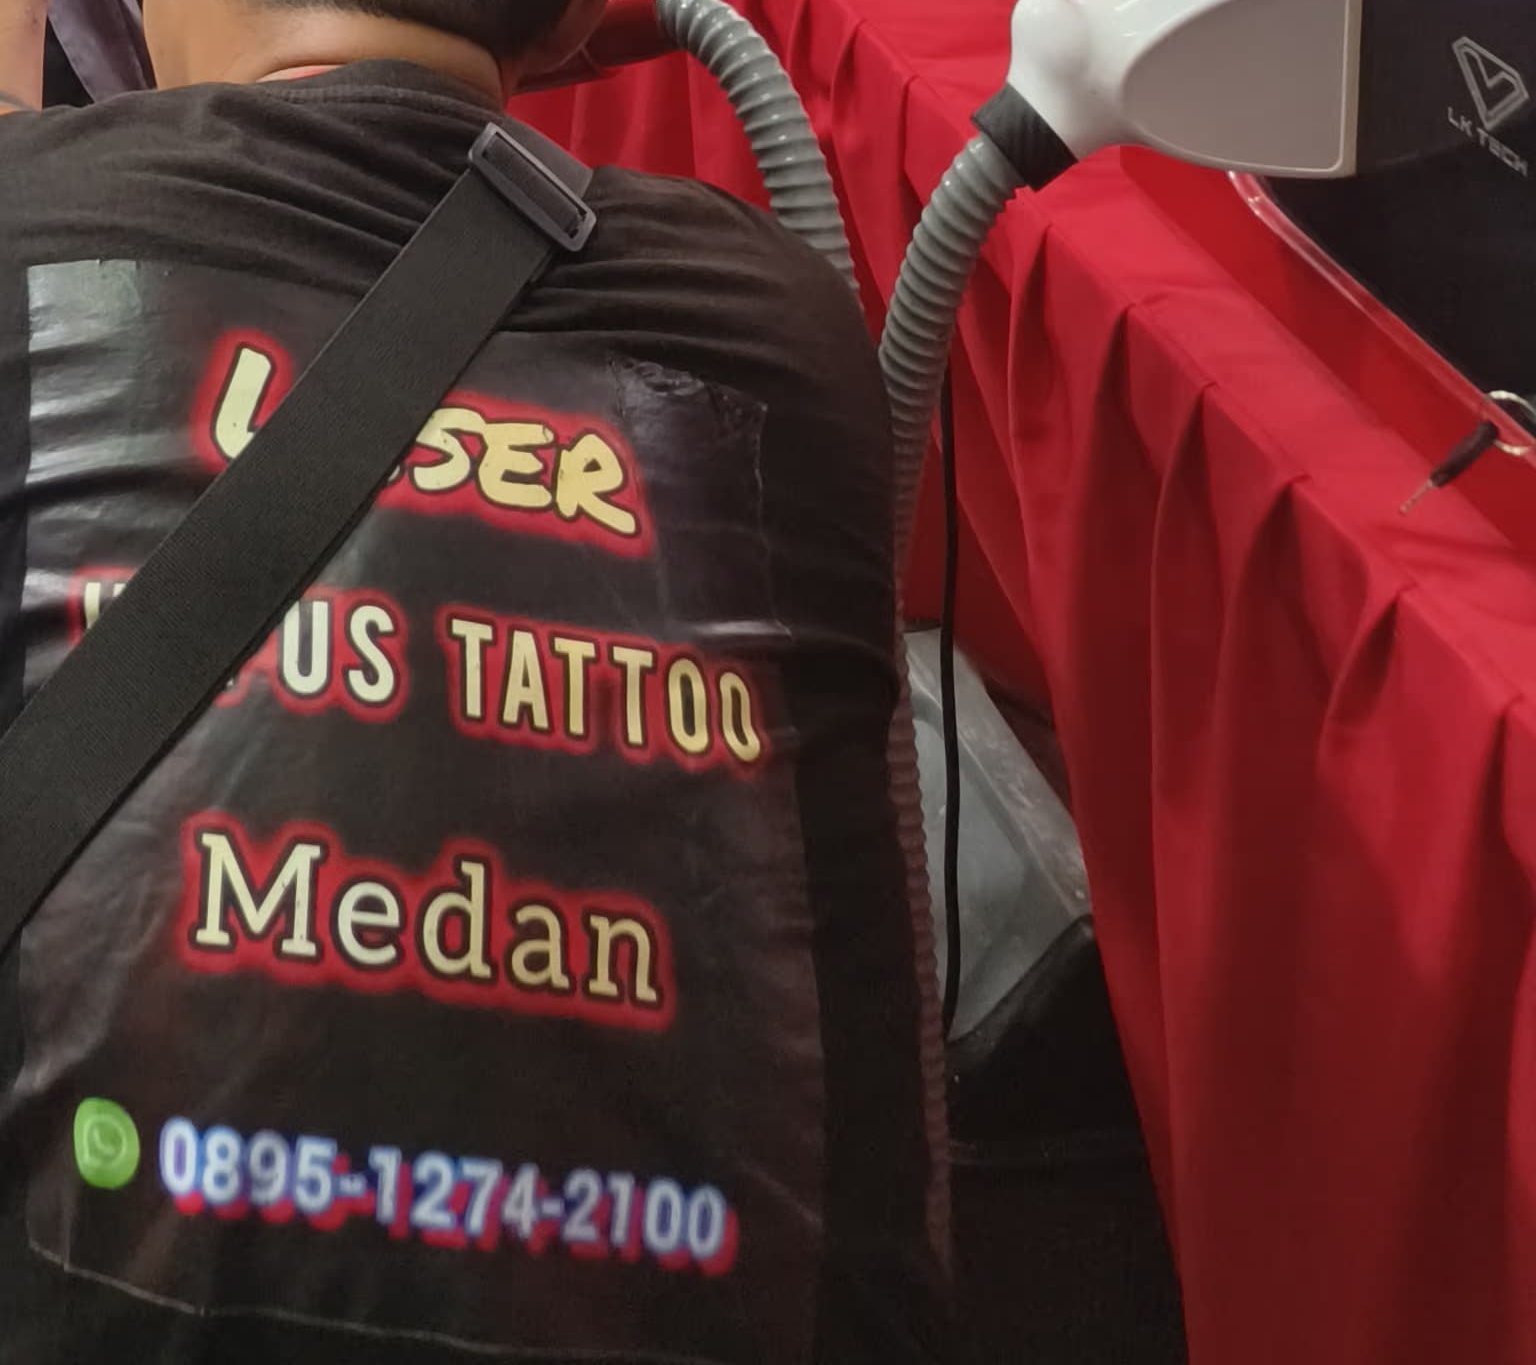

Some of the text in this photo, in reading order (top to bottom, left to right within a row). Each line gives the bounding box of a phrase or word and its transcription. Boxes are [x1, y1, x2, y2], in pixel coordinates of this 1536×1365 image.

[210, 344, 639, 536] LSER
[451, 618, 763, 764] TATTOO
[194, 831, 662, 1004] Medan
[158, 1115, 730, 1261] 0895-1274-2100
